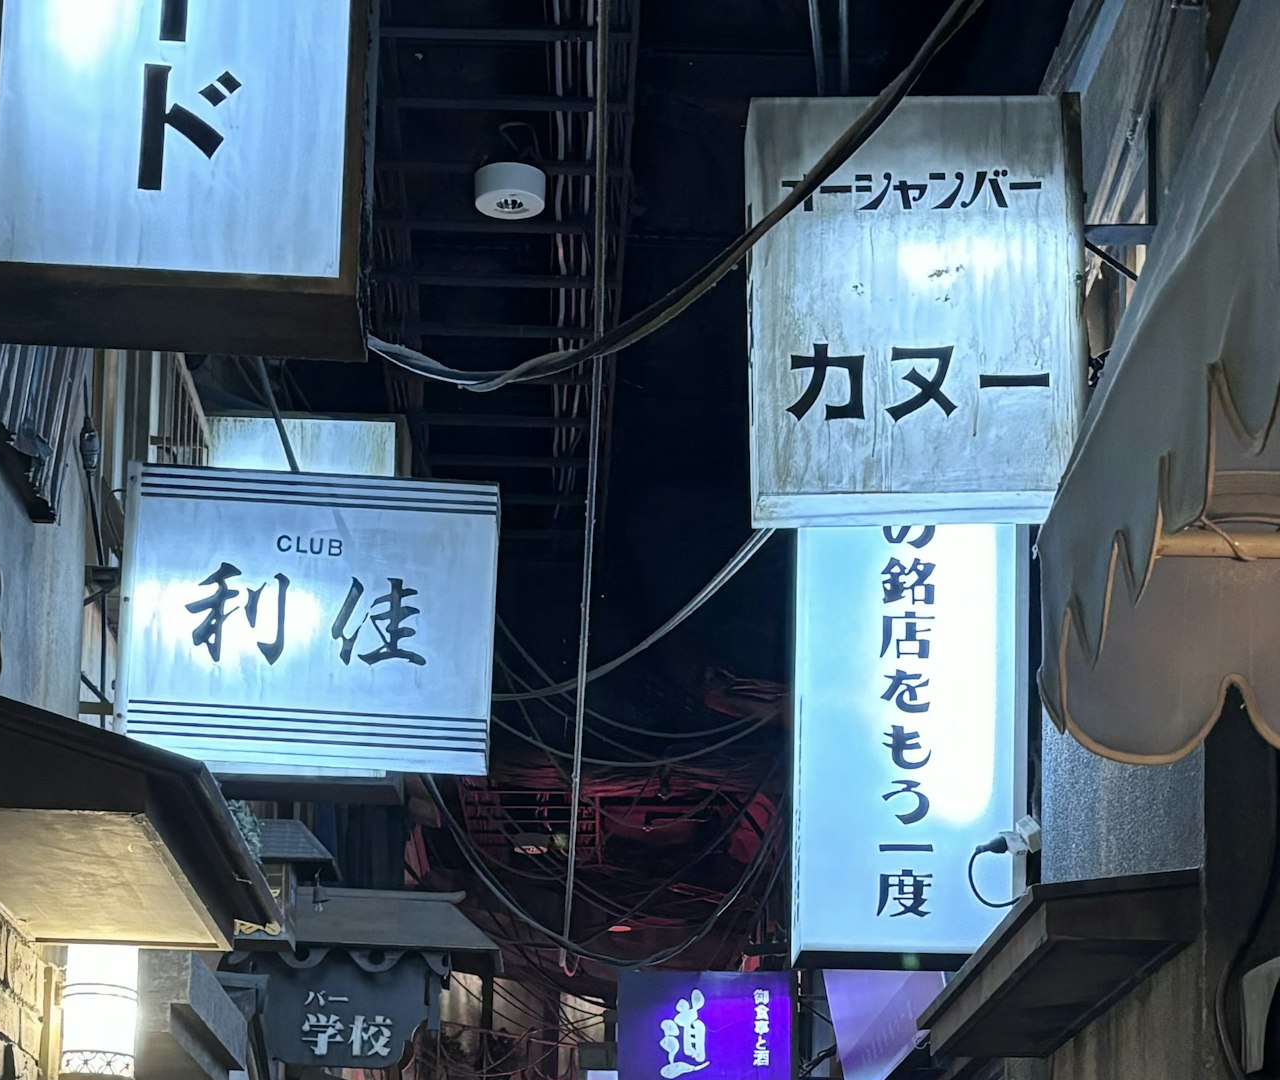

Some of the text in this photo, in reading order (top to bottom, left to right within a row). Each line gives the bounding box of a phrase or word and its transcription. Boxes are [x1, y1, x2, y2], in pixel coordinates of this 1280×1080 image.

[786, 342, 1051, 423] カヌー
[276, 534, 344, 558] CLUB
[304, 990, 349, 1007] バー
[301, 1013, 394, 1057] 学校
